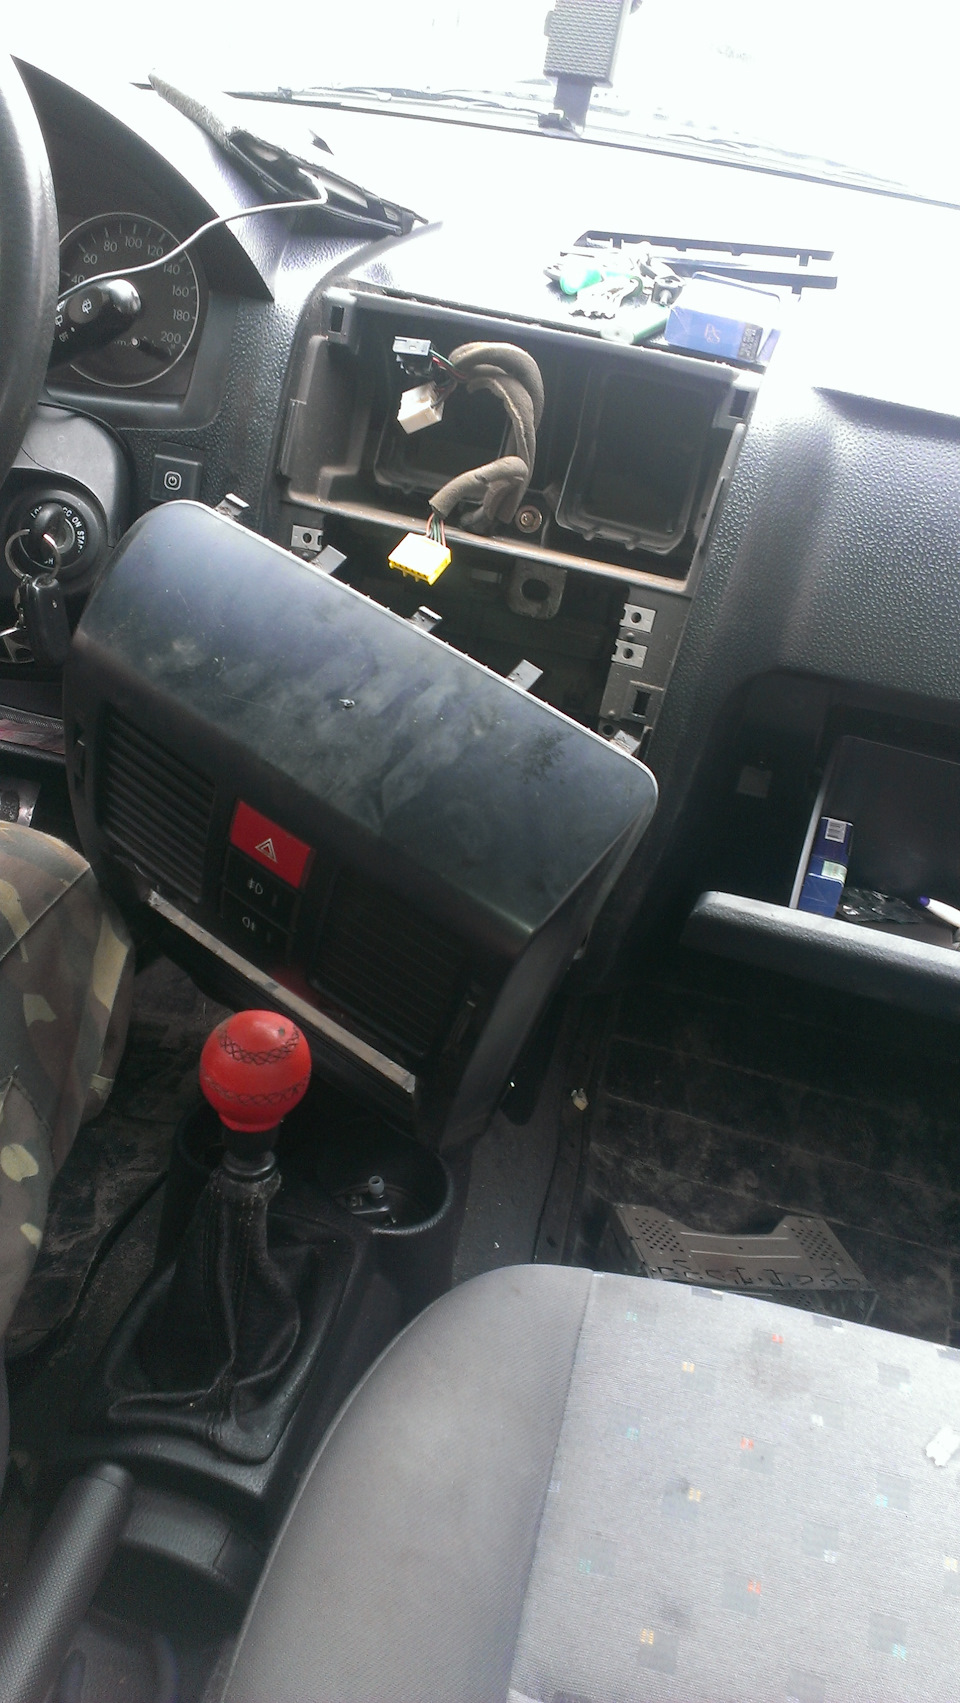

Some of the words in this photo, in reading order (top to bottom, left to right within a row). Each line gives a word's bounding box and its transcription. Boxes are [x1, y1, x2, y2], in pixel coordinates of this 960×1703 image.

[103, 241, 118, 252] 80
[125, 236, 142, 249] 100
[147, 244, 164, 257] 120
[83, 253, 98, 265] 60
[163, 264, 180, 275] 140
[71, 275, 86, 284] 40
[172, 285, 189, 297] 160
[173, 309, 190, 321] 180
[161, 331, 181, 344] 200
[72, 516, 82, 528] ON
[77, 530, 85, 553] STAR
